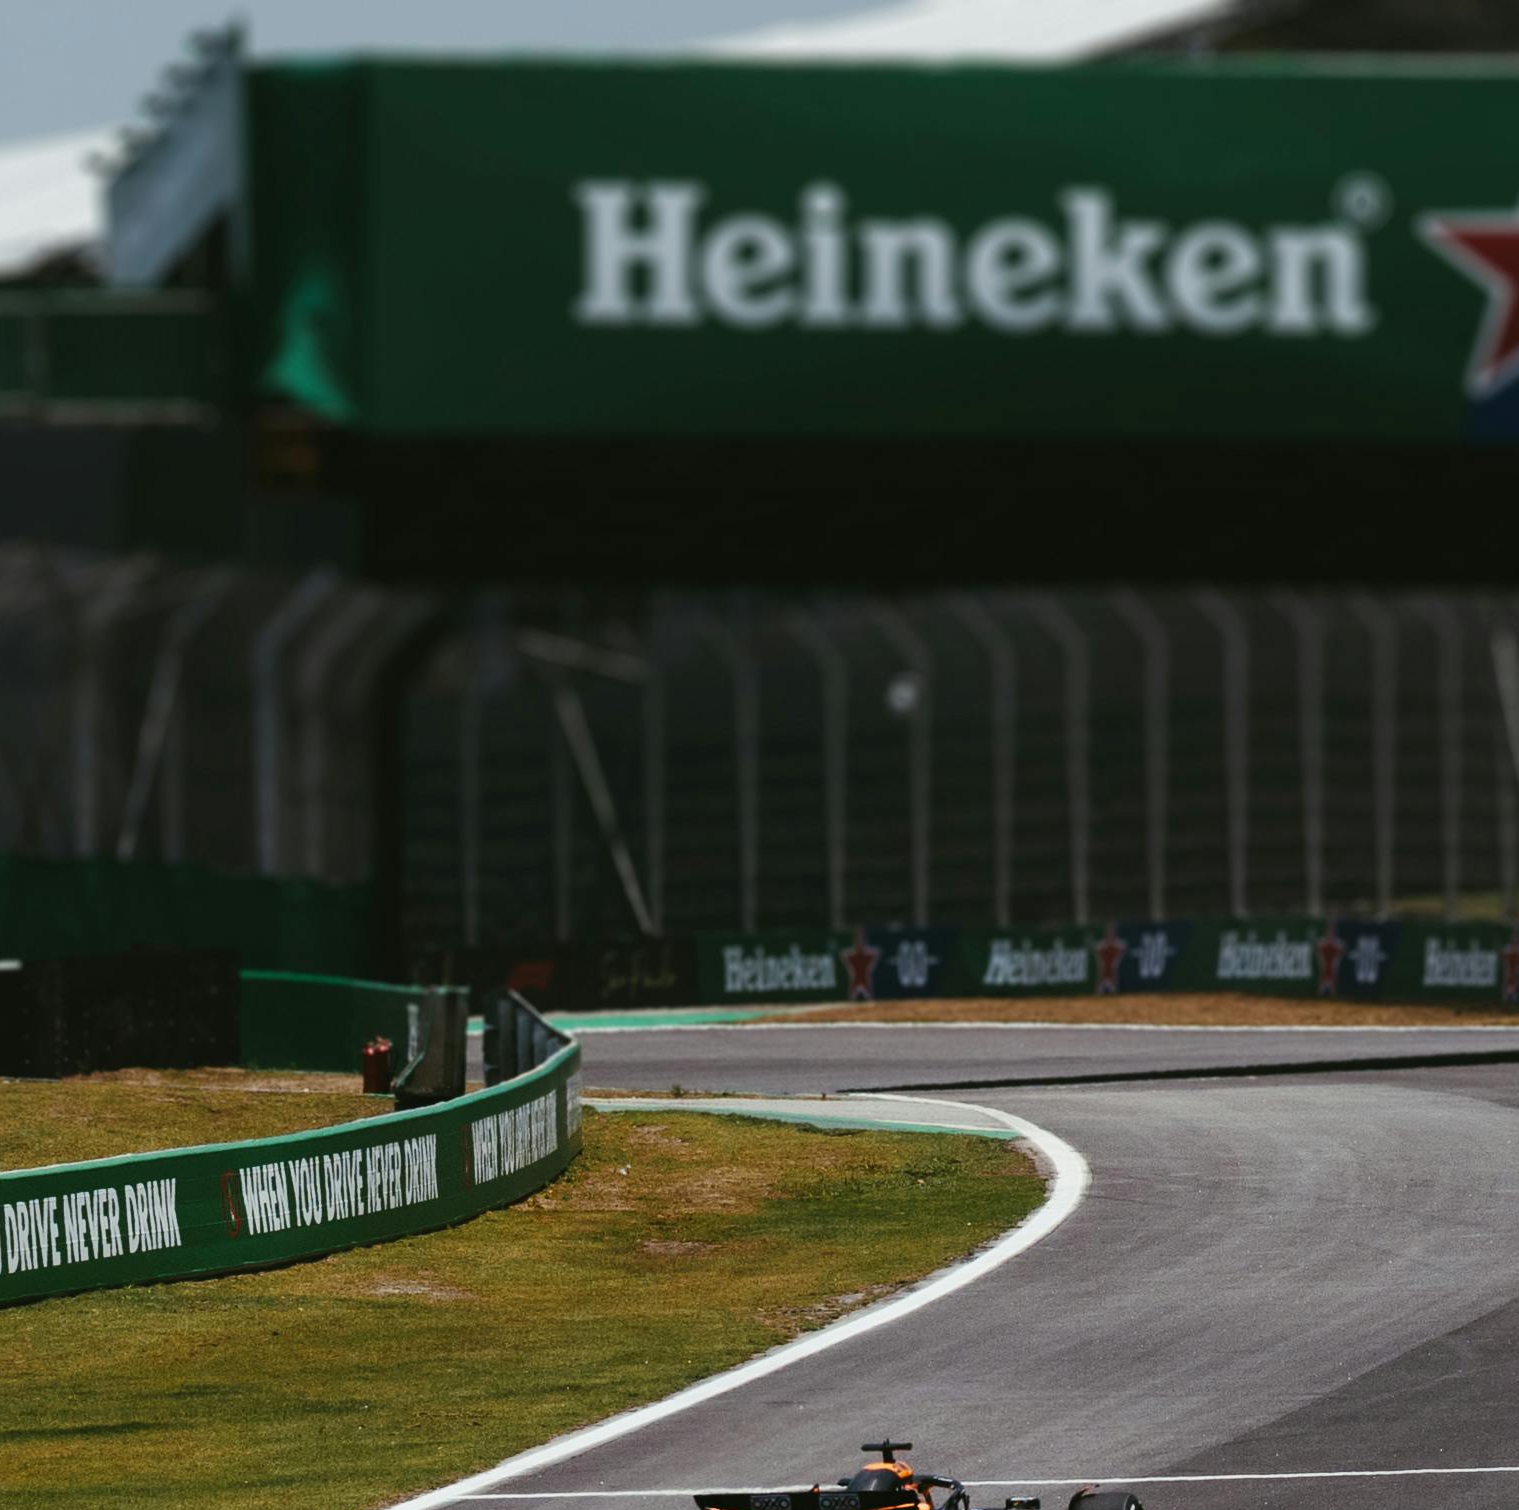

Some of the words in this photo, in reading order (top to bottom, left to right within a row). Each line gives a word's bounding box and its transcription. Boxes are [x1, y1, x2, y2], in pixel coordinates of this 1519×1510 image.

[574, 179, 1376, 333] Heineken
[722, 943, 836, 993] Heineken
[3, 1197, 61, 1274] DRIVE
[63, 1188, 124, 1263] NEVER
[125, 1178, 182, 1253] DRINK
[239, 1162, 291, 1236] WHEN
[288, 1156, 323, 1227] YOU
[323, 1149, 365, 1221] DRIVE
[366, 1142, 403, 1214] NEVER
[404, 1134, 439, 1205] DRINK
